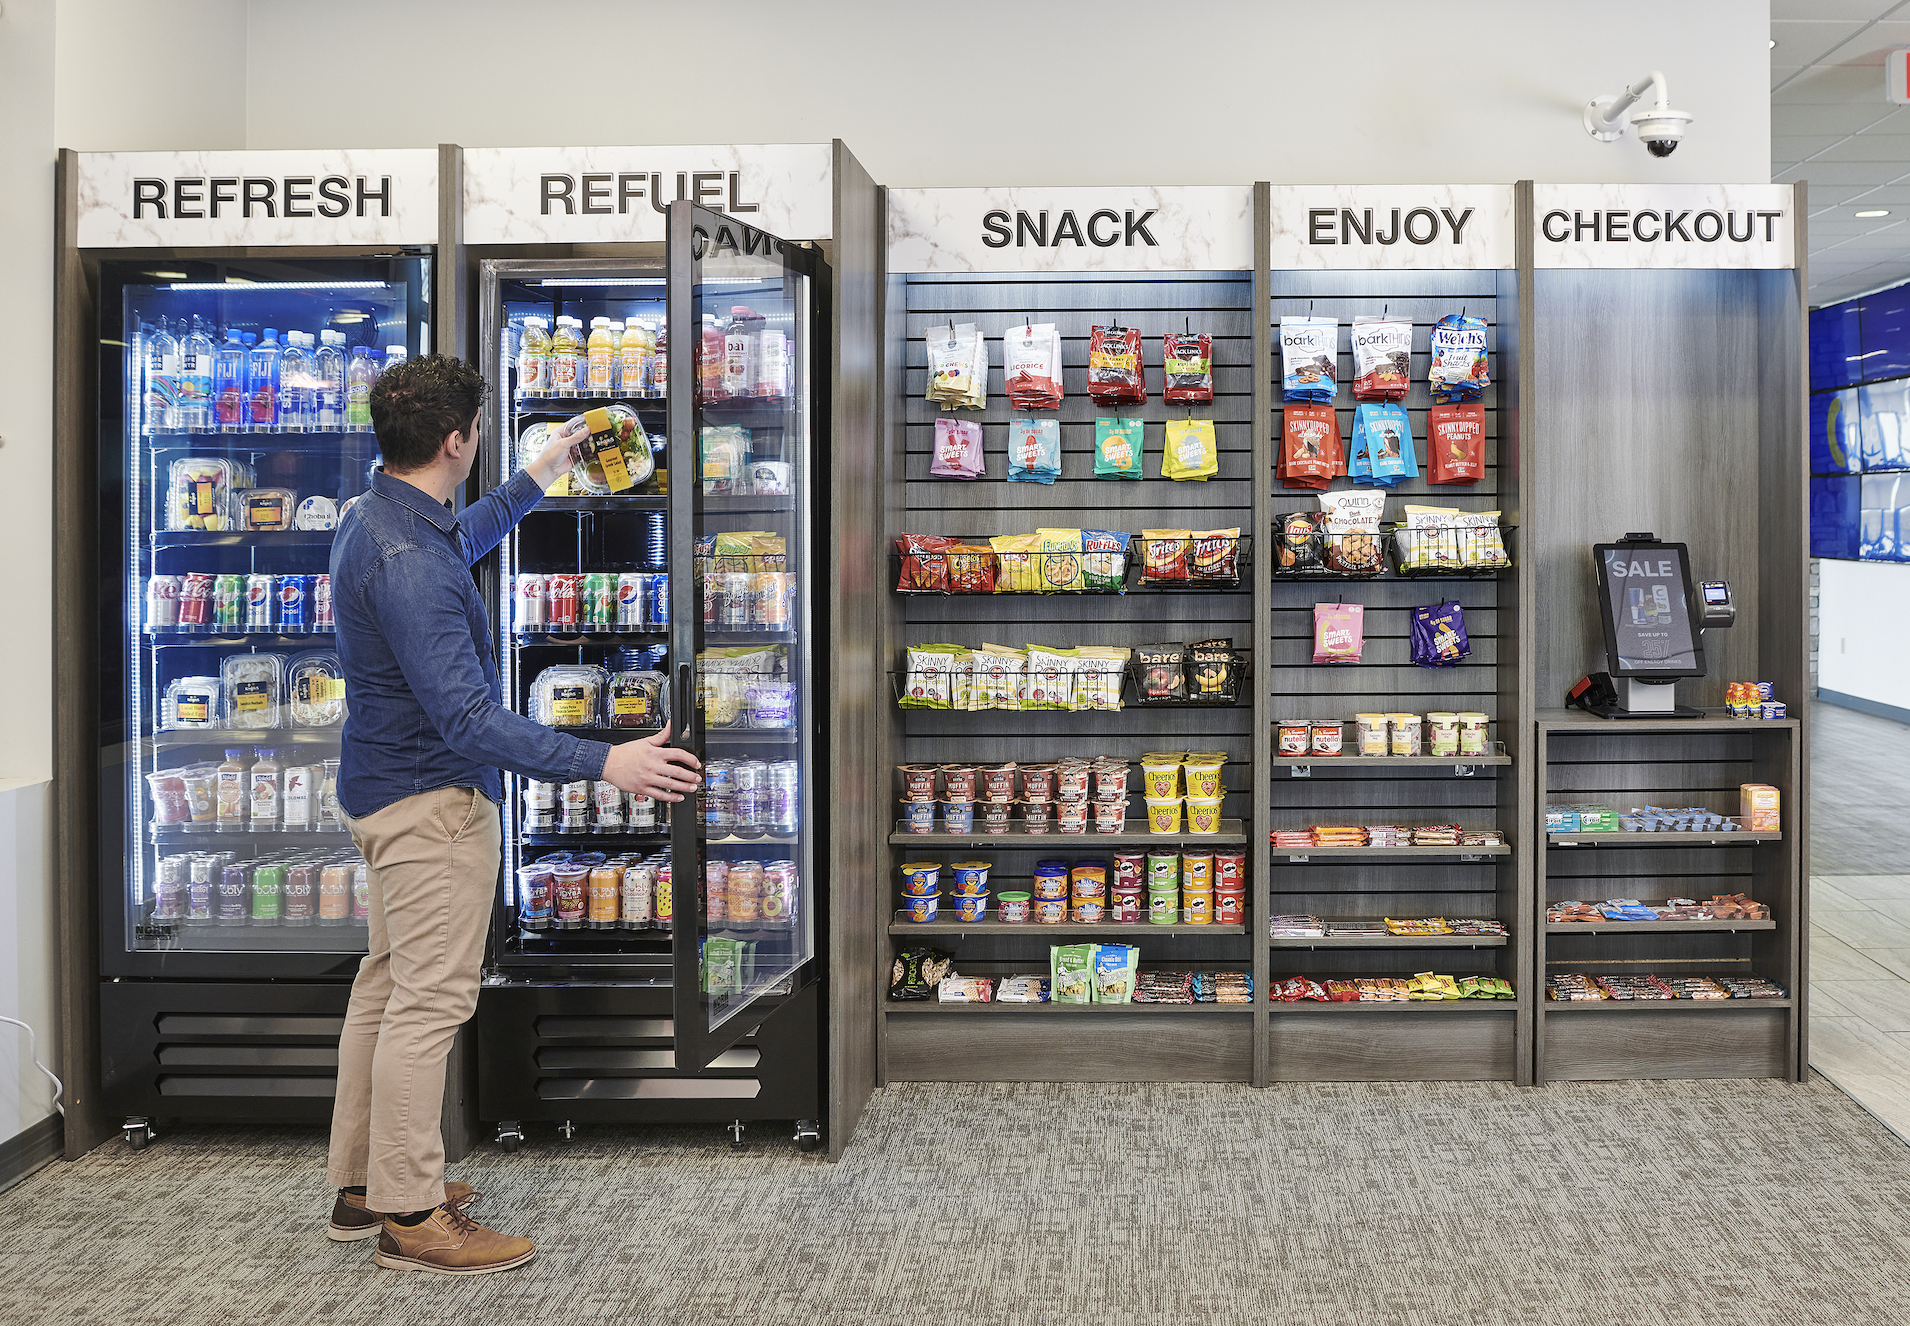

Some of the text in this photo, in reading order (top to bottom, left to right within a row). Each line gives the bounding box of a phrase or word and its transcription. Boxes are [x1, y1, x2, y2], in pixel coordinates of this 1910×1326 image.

[133, 176, 391, 219] REFRESH
[540, 171, 760, 214] REFUEL
[981, 209, 1160, 248] SNACK
[1308, 206, 1476, 246] ENJOY
[1541, 208, 1784, 244] CHECKOUT
[1440, 332, 1484, 345] Welch's
[728, 342, 744, 352] bai
[217, 363, 237, 378] FIJI
[252, 361, 272, 377] FIJI
[940, 444, 968, 454] SMART
[1016, 443, 1044, 454] SMART
[1105, 444, 1132, 454] SMART
[1178, 442, 1204, 454] SMART
[939, 450, 969, 461] SWEETS
[1016, 450, 1046, 462] SWEETS
[1104, 449, 1133, 462] SWEETS
[1178, 448, 1207, 462] SWEETS
[1416, 514, 1448, 525] SKINNY
[1463, 516, 1495, 527] SKINNY
[1086, 540, 1122, 552] RUFFLES
[1148, 541, 1181, 559] Fritos
[1612, 561, 1674, 578] SALE
[657, 584, 668, 614] pepsi
[283, 609, 299, 618] pepsi
[1324, 630, 1351, 639] SMART
[1434, 630, 1457, 646] SMART
[1324, 636, 1352, 648] SWEETS
[1436, 636, 1460, 654] SWEETS
[1642, 640, 1672, 658] 25%
[918, 655, 951, 667] SKINNY
[982, 655, 1015, 667] SKINNY
[1036, 656, 1070, 669] SKINNY
[1139, 652, 1180, 664] bare
[1194, 650, 1230, 663] bare
[1078, 660, 1110, 669] SKINNY
[1148, 771, 1176, 782] Cheerios
[1150, 805, 1178, 816] Cheerios
[1190, 805, 1218, 816] Cheerios
